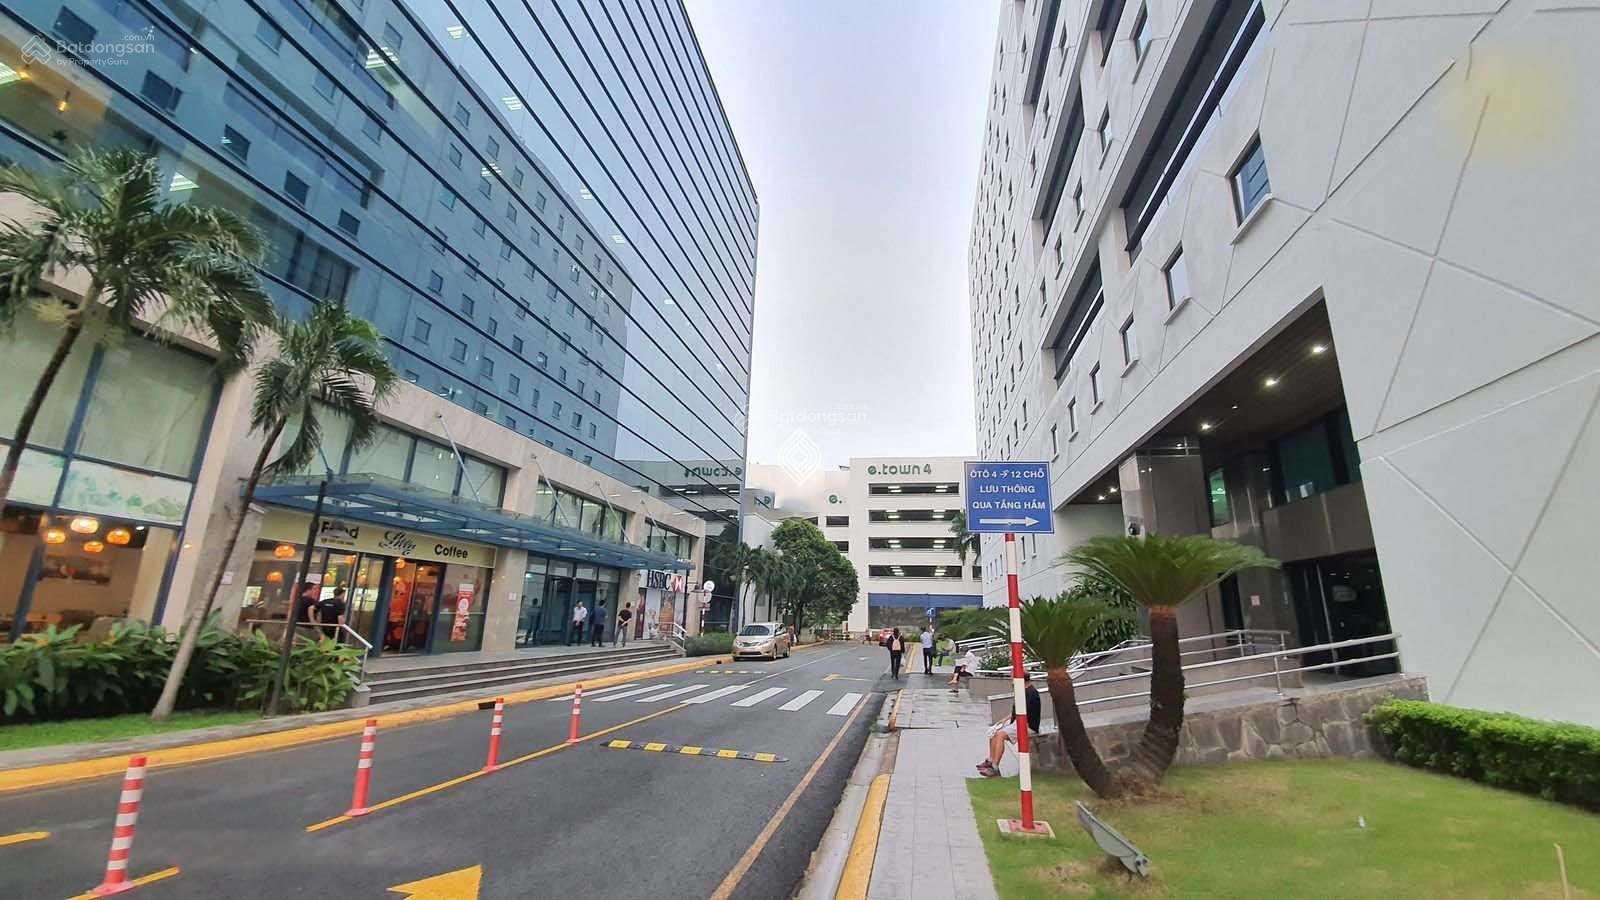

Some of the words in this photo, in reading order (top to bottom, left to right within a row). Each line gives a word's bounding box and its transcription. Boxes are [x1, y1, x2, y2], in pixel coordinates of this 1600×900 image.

[867, 464, 920, 475] e.town
[923, 463, 932, 475] 4
[991, 470, 998, 478] 4
[1011, 470, 1022, 479] 12
[1001, 484, 1036, 494] THÔNG
[972, 502, 993, 510] QUA
[321, 521, 360, 539] Fd
[434, 543, 469, 559] Coffee
[647, 570, 672, 590] HSBC
